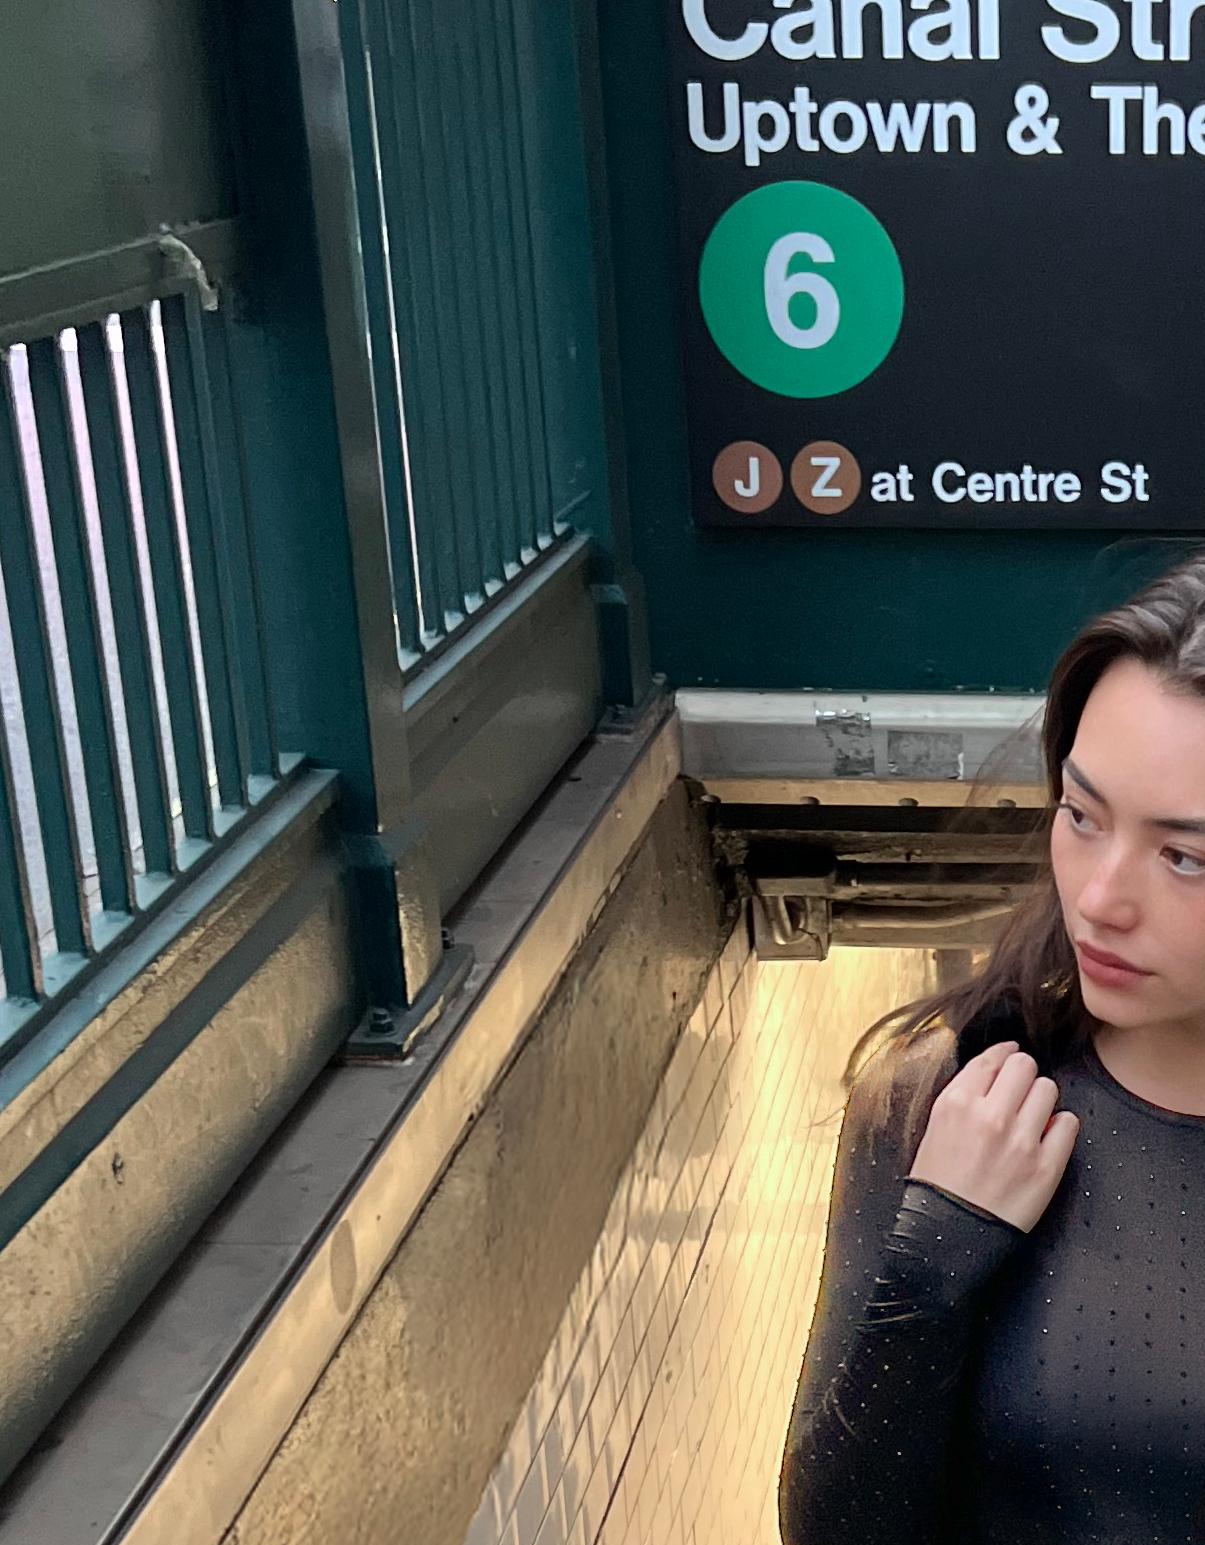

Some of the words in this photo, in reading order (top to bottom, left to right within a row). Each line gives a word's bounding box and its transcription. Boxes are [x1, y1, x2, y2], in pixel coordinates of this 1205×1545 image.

[682, 0, 1001, 61] Canal
[686, 82, 976, 167] Uptown
[1006, 83, 1064, 156] &
[764, 232, 840, 349] 6
[734, 456, 760, 498] J
[809, 456, 843, 498] Z
[870, 464, 915, 502] at
[931, 462, 1082, 503] Centre
[1100, 462, 1150, 503] St
